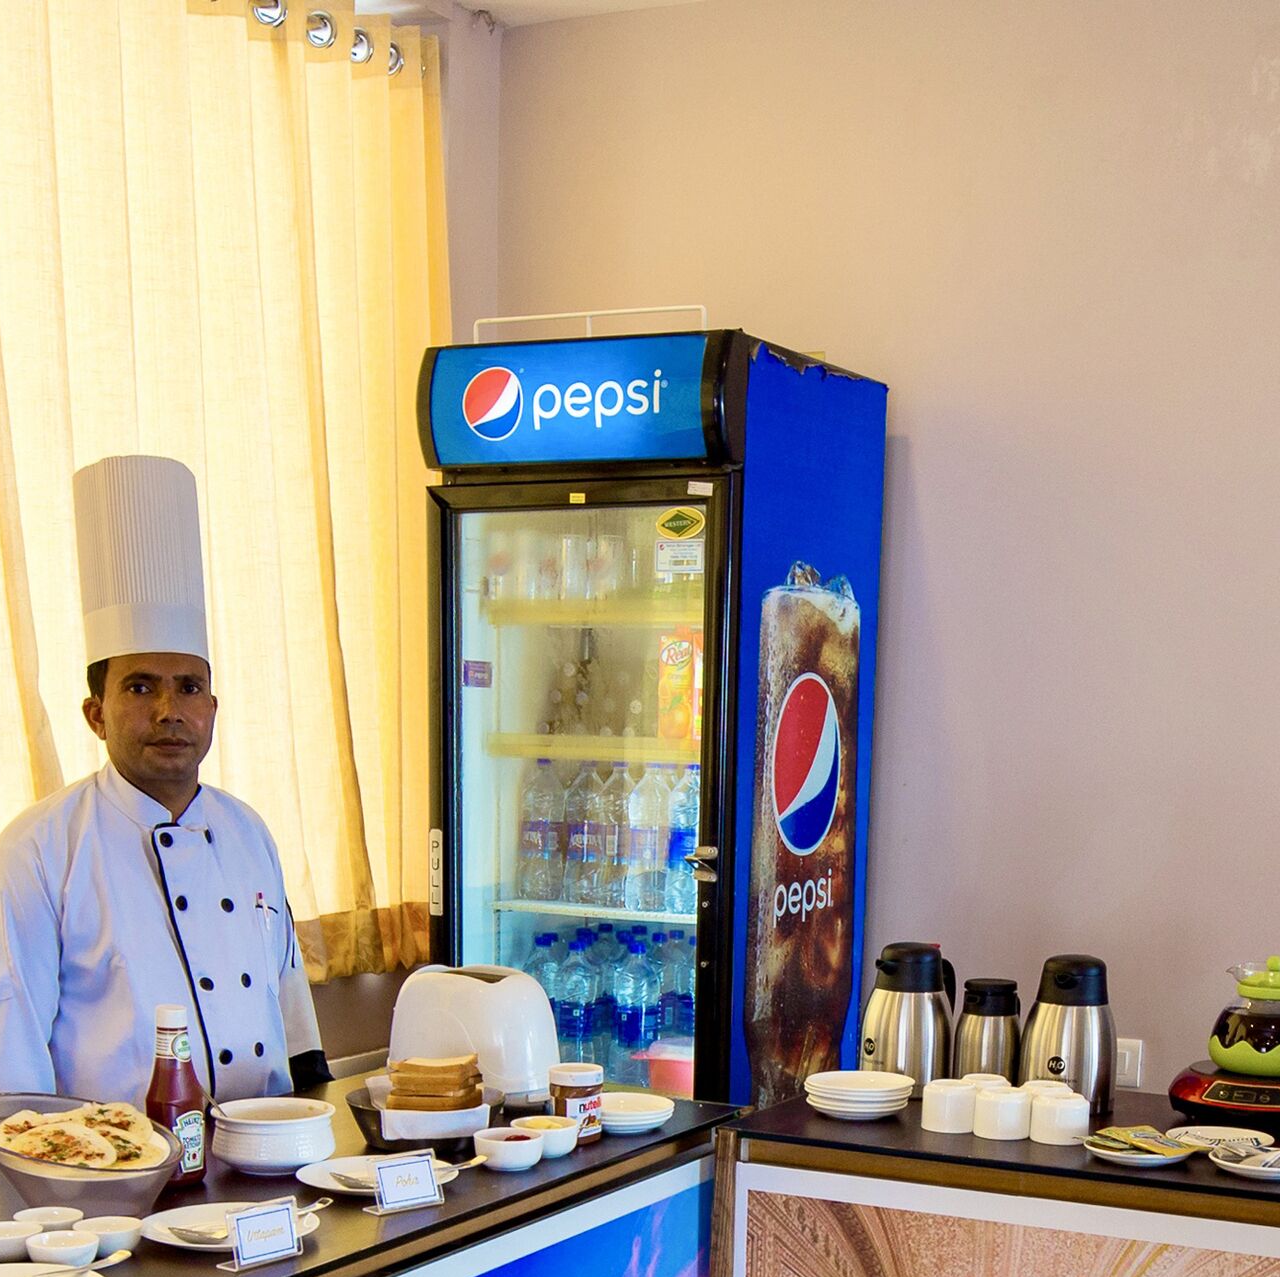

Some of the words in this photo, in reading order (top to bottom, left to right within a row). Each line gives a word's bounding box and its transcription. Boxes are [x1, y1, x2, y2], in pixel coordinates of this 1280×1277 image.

[532, 368, 662, 431] pepsi
[431, 840, 440, 905] PULL
[773, 867, 833, 929] pepsi
